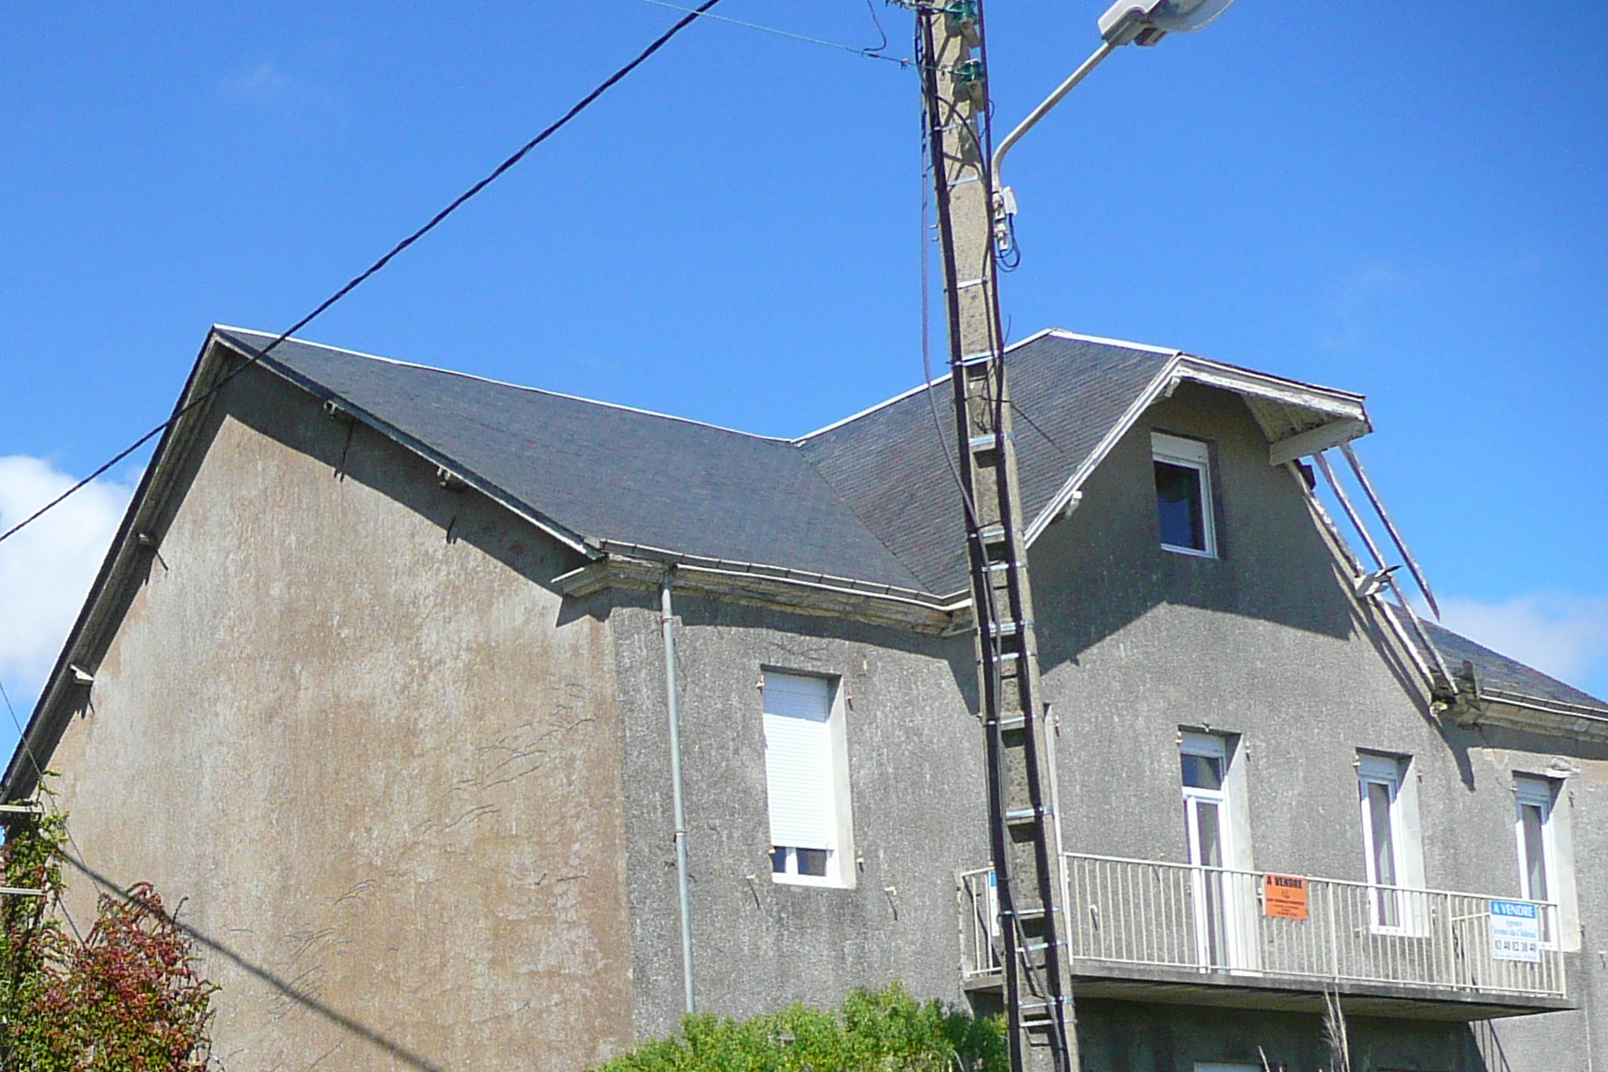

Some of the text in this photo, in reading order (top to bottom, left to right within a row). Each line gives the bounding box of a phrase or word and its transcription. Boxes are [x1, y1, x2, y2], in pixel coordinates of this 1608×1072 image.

[1267, 875, 1303, 889] A VENDRE
[1493, 903, 1533, 917] A VENDRE
